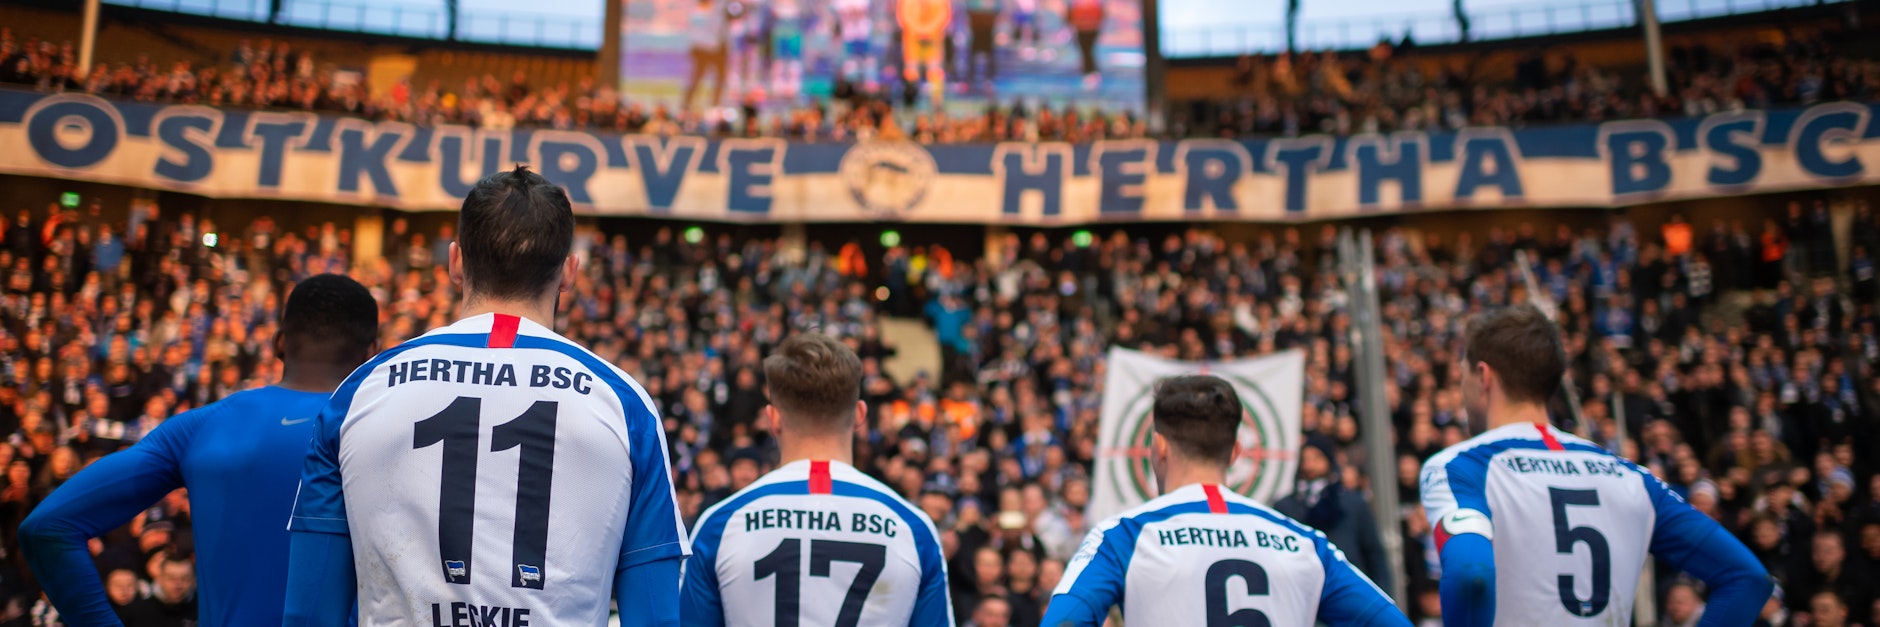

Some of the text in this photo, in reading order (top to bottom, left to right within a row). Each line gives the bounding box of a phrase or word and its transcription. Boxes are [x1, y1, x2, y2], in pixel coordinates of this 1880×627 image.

[24, 97, 776, 214] OSTKURVE
[1000, 109, 1867, 215] HERTHA BSC
[387, 358, 593, 396] HERTHA BSC
[413, 396, 559, 591] 11
[1502, 456, 1624, 478] HERTHA BSC
[745, 508, 897, 539] HERTHA BSC
[1158, 527, 1299, 553] HERTHA BSC
[1548, 486, 1611, 618] 5
[431, 601, 531, 627] LECKIE
[754, 538, 887, 627] 17
